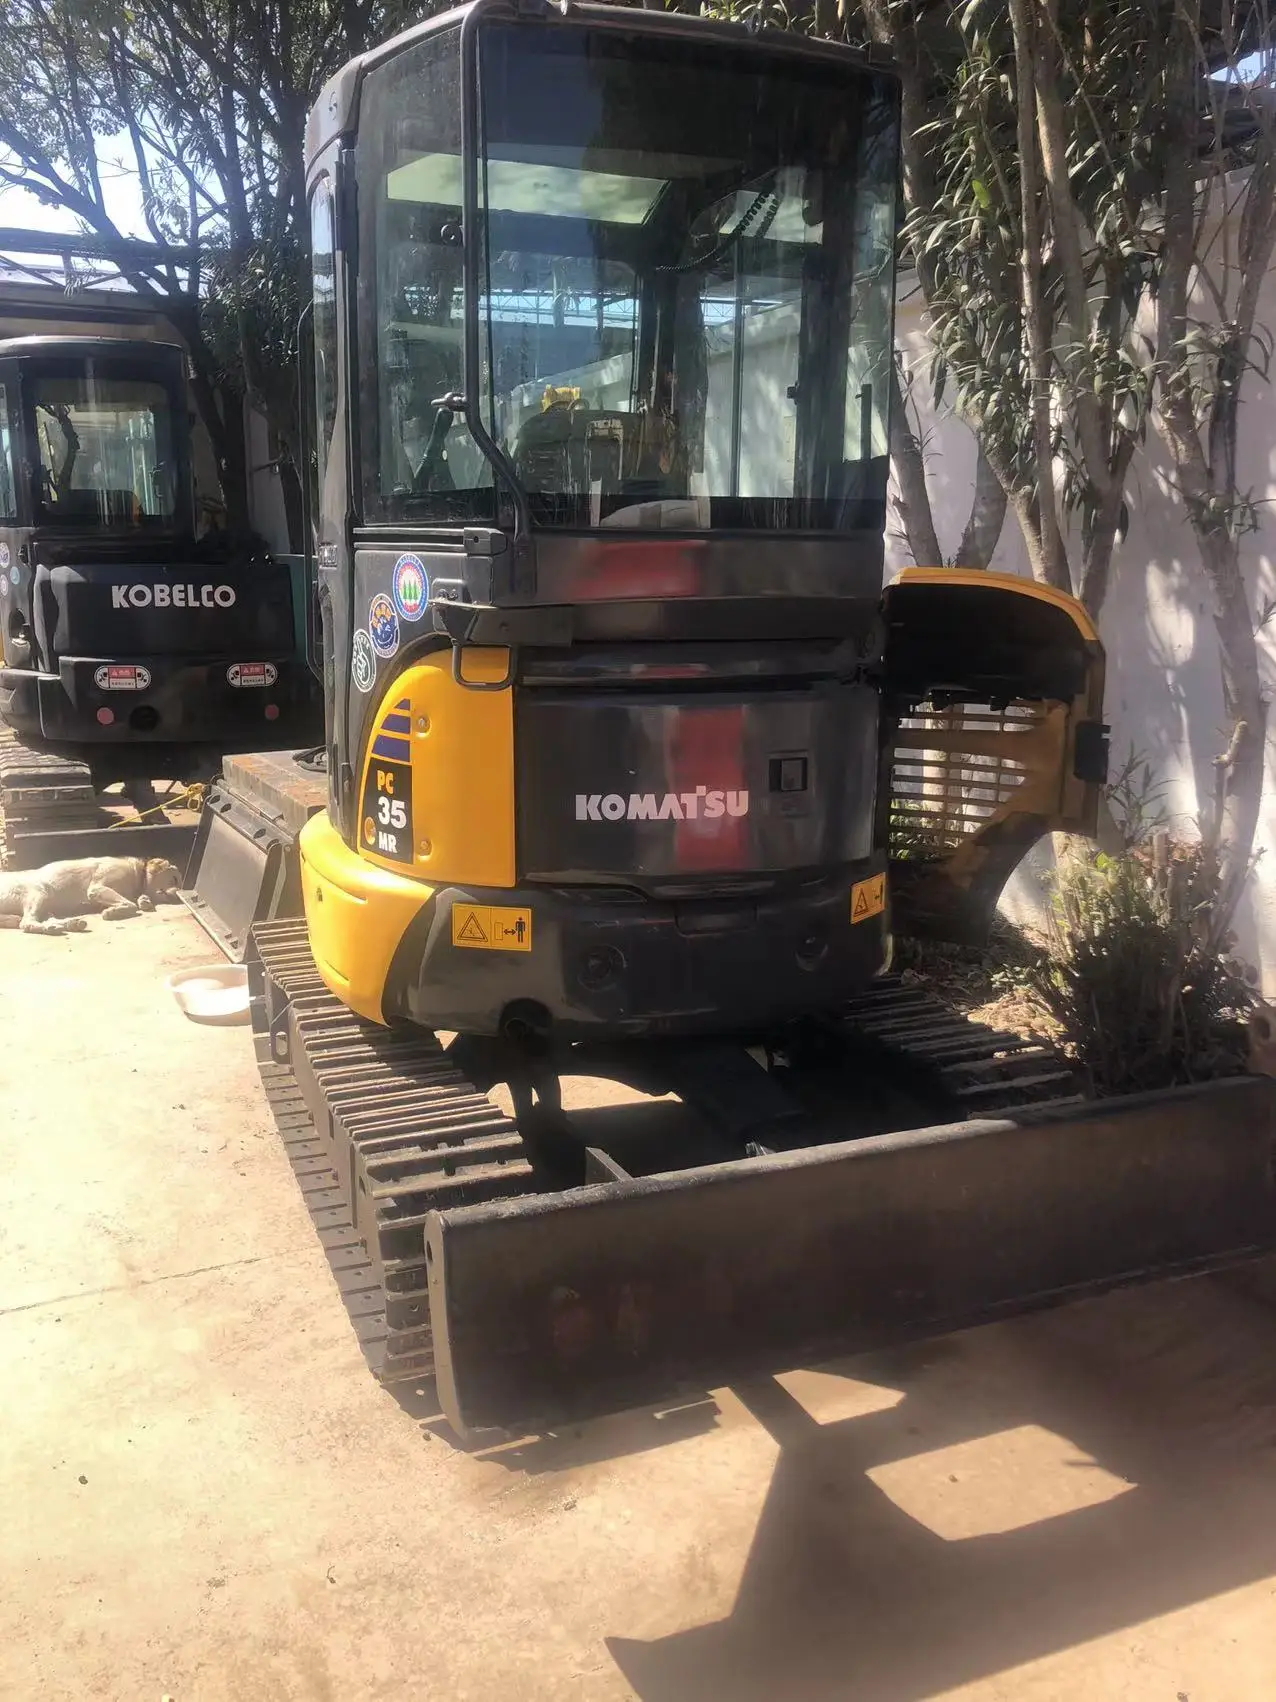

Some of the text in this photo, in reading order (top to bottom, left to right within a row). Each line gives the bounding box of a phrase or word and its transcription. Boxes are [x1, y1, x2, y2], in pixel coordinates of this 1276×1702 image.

[111, 584, 236, 609] KOBELCO
[377, 770, 394, 795] PC
[378, 796, 407, 829] 35
[575, 785, 749, 821] KOMATSU
[378, 831, 398, 854] MR
